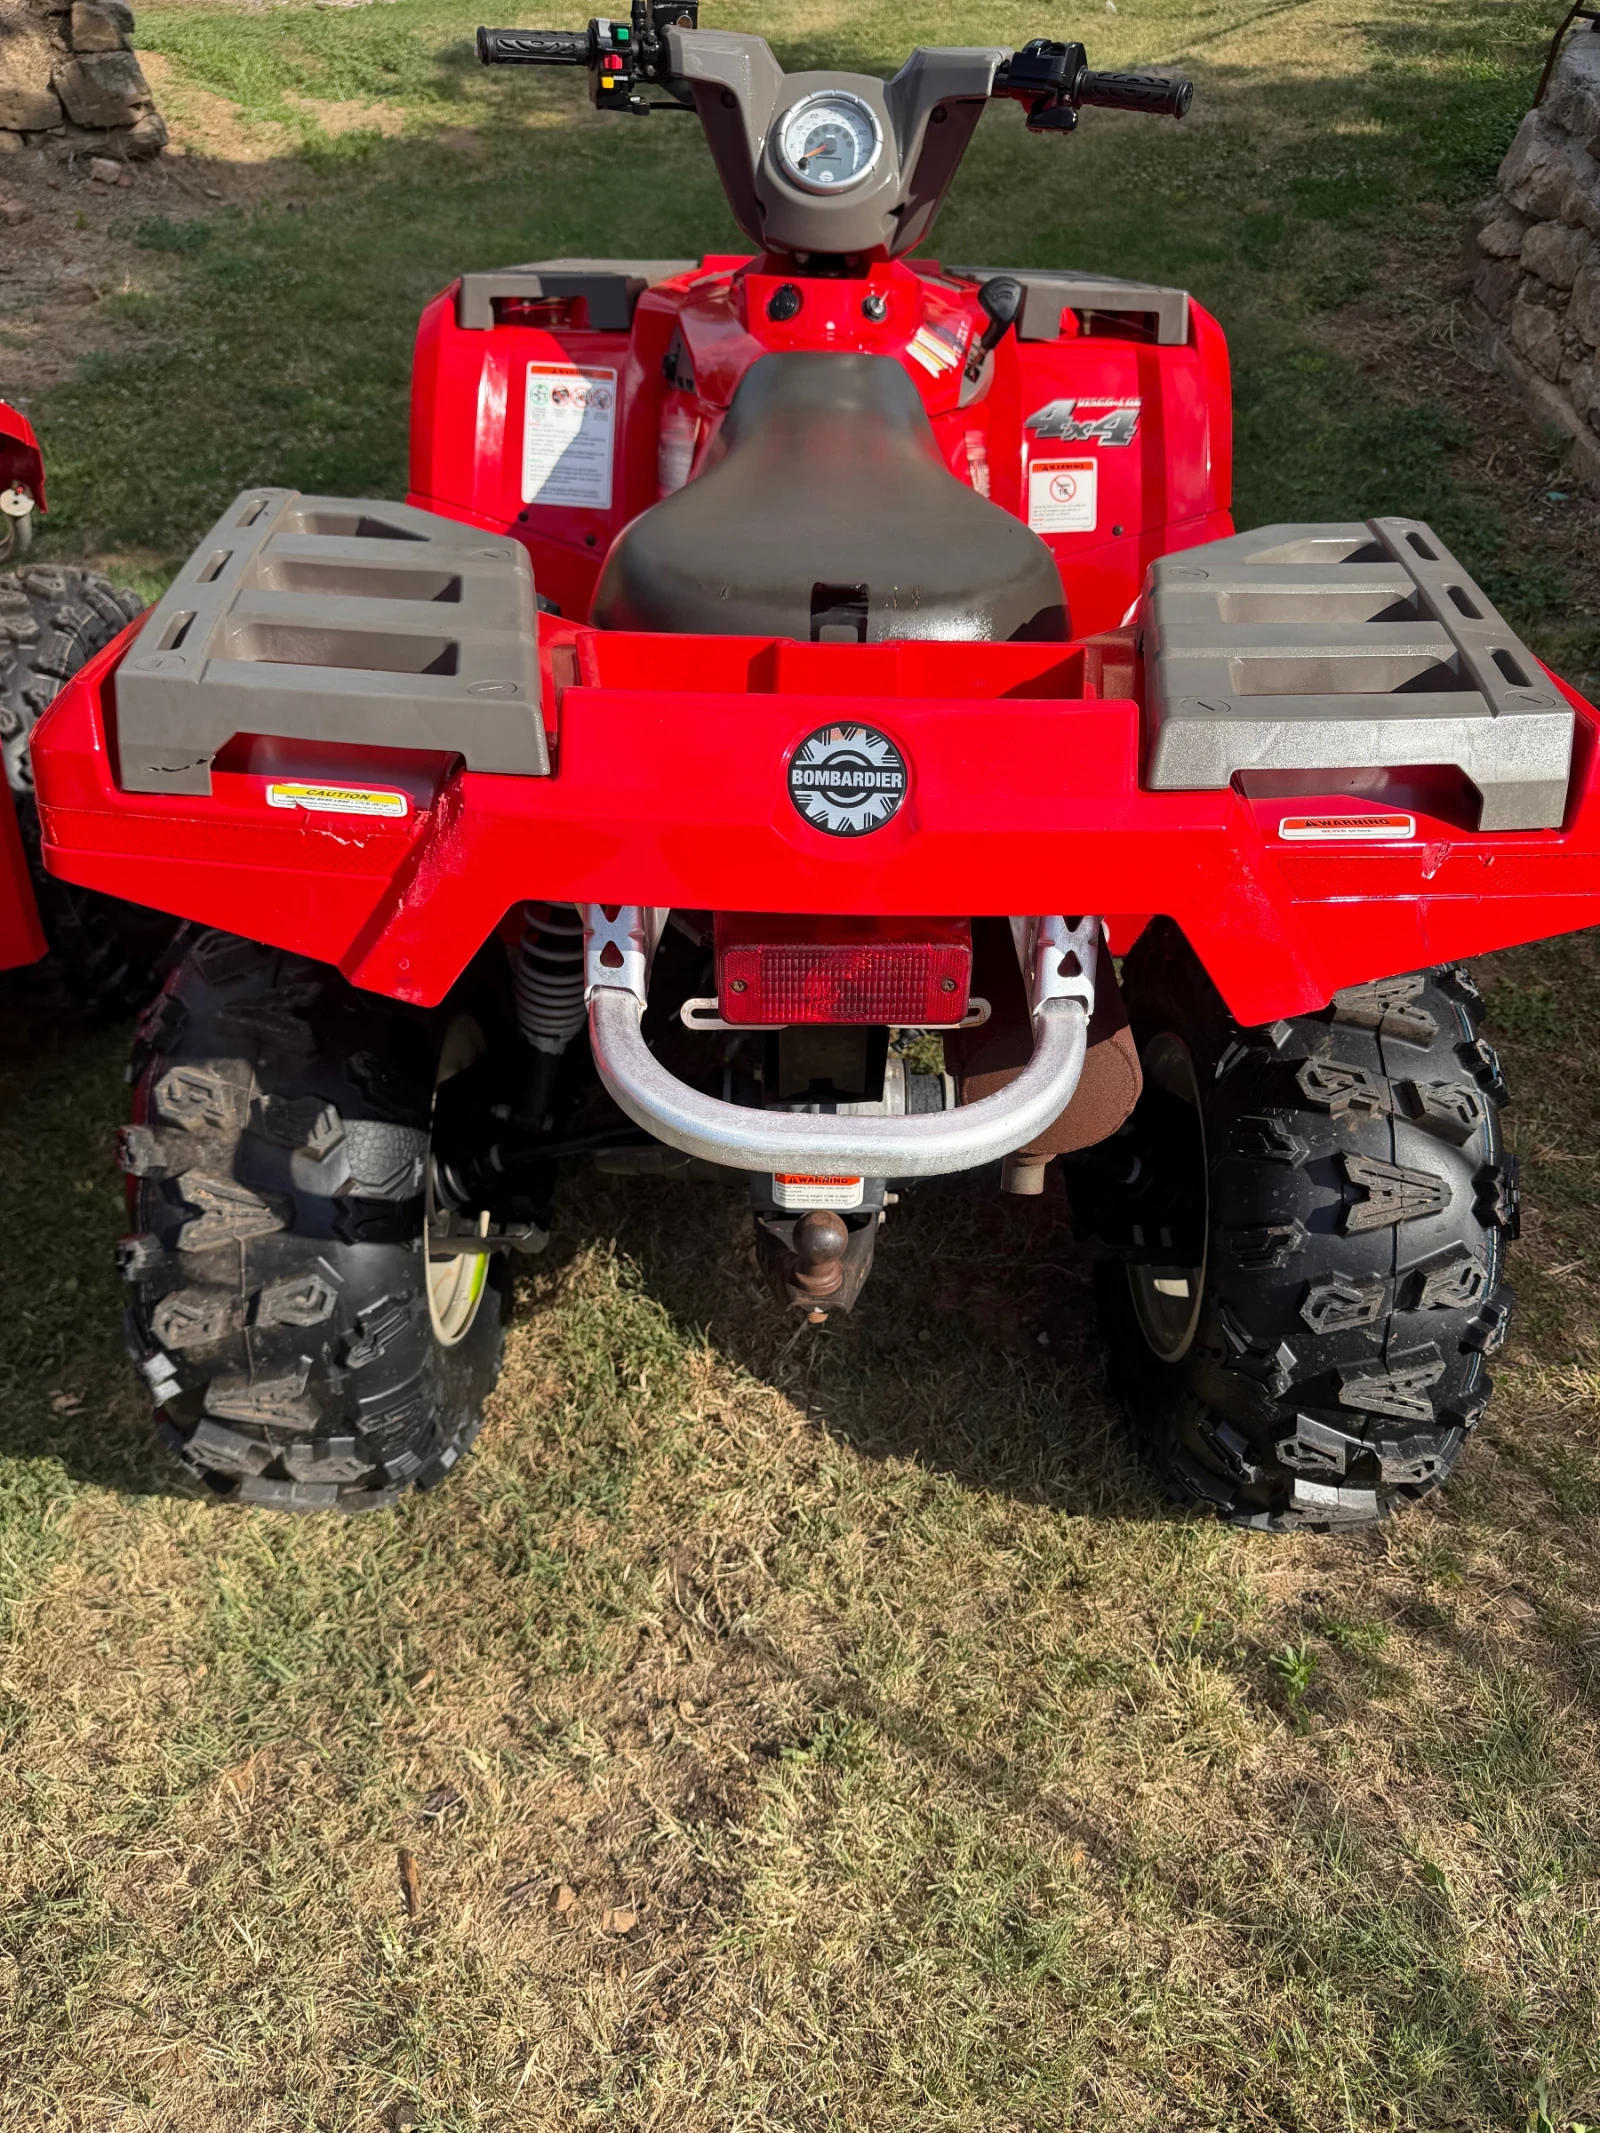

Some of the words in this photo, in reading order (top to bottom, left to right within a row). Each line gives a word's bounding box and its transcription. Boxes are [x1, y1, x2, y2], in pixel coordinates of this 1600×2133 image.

[1024, 399, 1140, 446] 4x4
[1049, 463, 1084, 471] WARNING
[791, 769, 902, 788] BOMBARDIER
[306, 789, 371, 800] CAUTION
[1317, 818, 1391, 827] WARNING
[798, 1176, 849, 1184] WARNING
